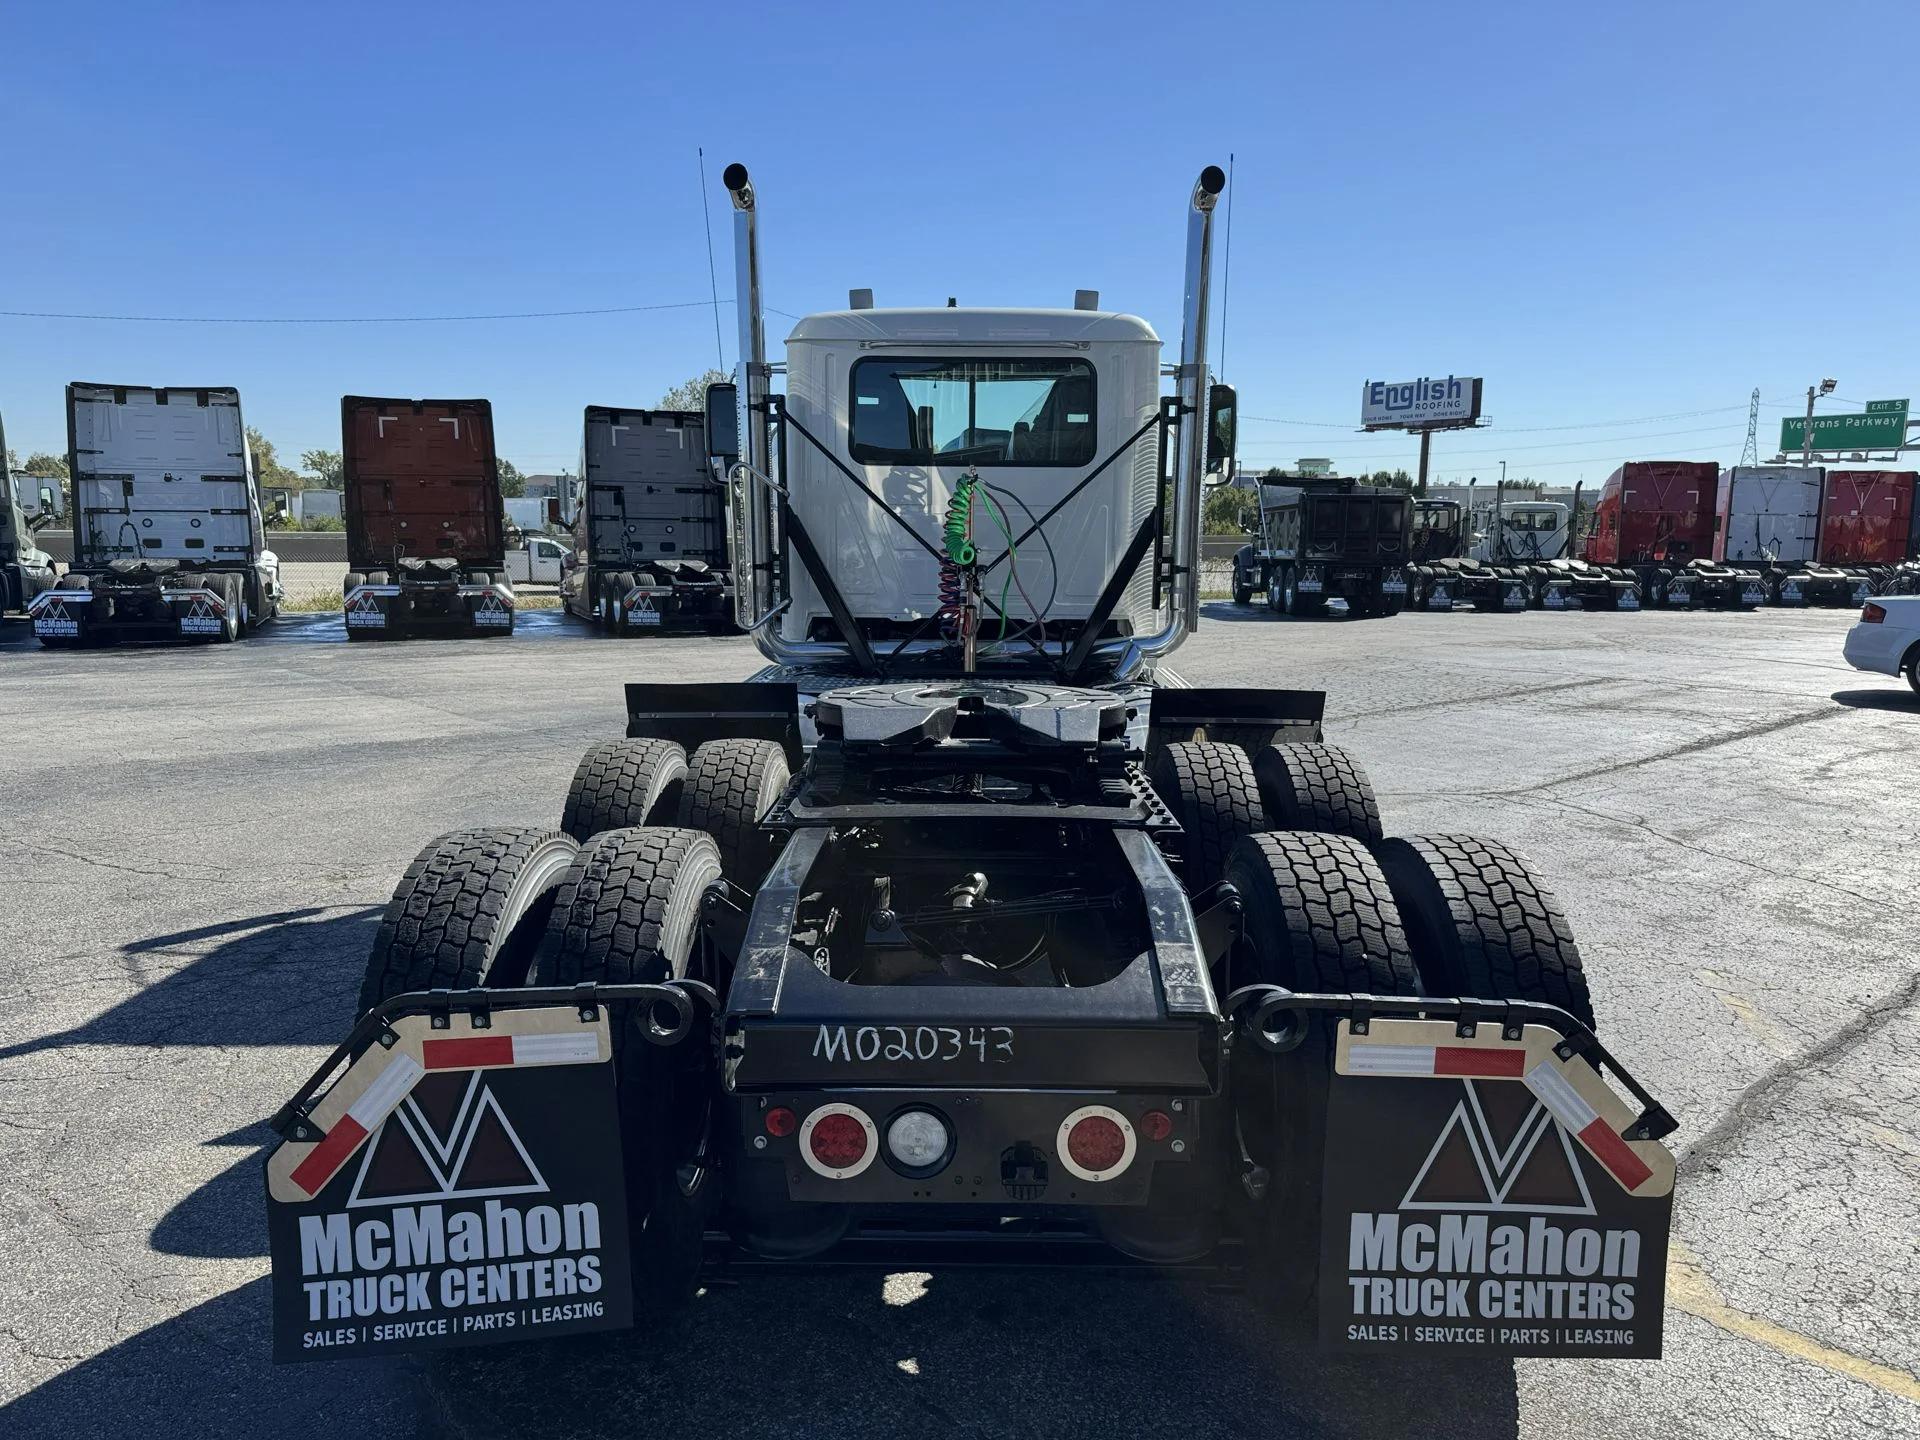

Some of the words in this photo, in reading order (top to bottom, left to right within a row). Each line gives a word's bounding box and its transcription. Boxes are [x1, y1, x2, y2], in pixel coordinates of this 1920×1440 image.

[1370, 374, 1462, 411] English
[1415, 401, 1461, 410] ROOFING
[1846, 417, 1898, 427] Parkway
[299, 1200, 601, 1276] McMahon
[1349, 1212, 1641, 1278] McMahon
[303, 1271, 432, 1321] TRUCK
[440, 1255, 602, 1308] CENTERS
[1349, 1277, 1470, 1317] TRUCK
[1479, 1279, 1634, 1321] CENTERS
[303, 1328, 356, 1348] SALES
[373, 1318, 447, 1342] SERVICE
[463, 1311, 516, 1332] PARTS
[531, 1301, 604, 1324] LEASING
[1347, 1324, 1398, 1341] SALES
[1414, 1326, 1485, 1344] SERVICE
[1500, 1328, 1550, 1344] PARTS
[1565, 1329, 1634, 1345] LEASING
